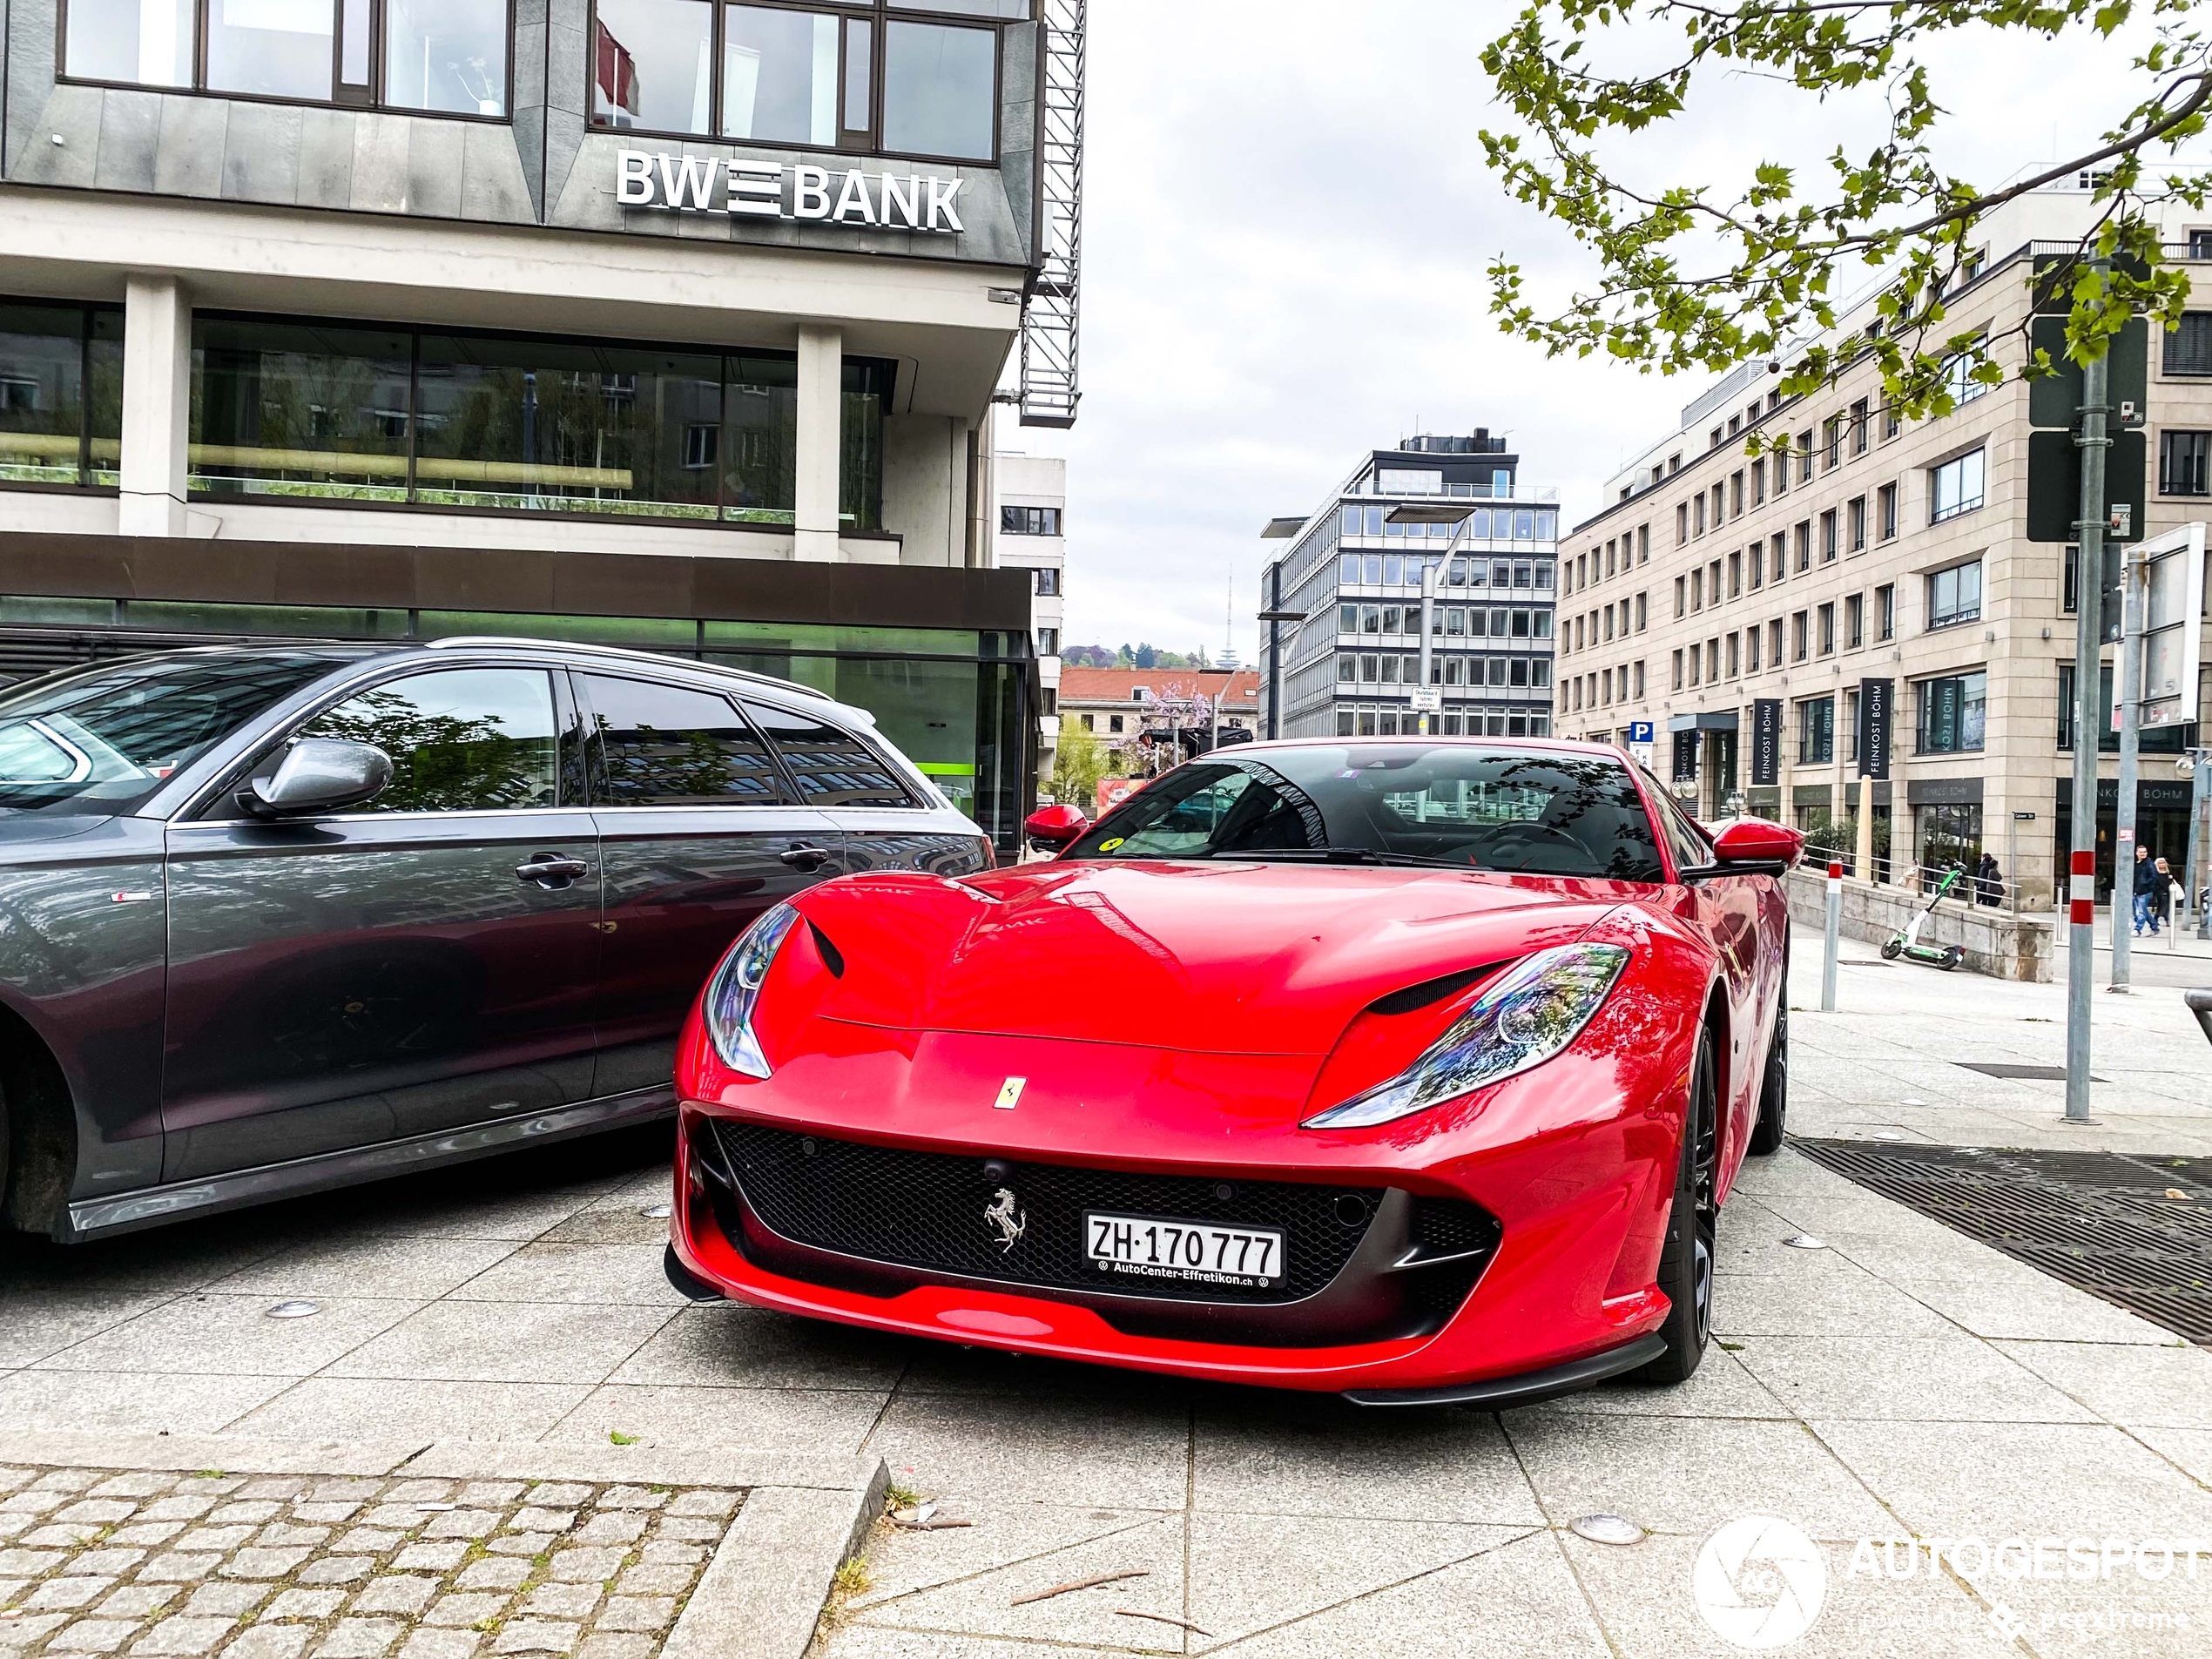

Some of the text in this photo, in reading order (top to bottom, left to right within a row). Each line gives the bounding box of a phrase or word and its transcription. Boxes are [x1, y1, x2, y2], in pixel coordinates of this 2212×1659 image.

[617, 148, 965, 233] BW BANK
[1635, 724, 1649, 740] P
[1762, 705, 1772, 779] FEINKOST BÖHM
[1871, 685, 1882, 772] FEINKOST BÖHM
[1113, 1261, 1253, 1286] AutoCenter-Effretikon.ch
